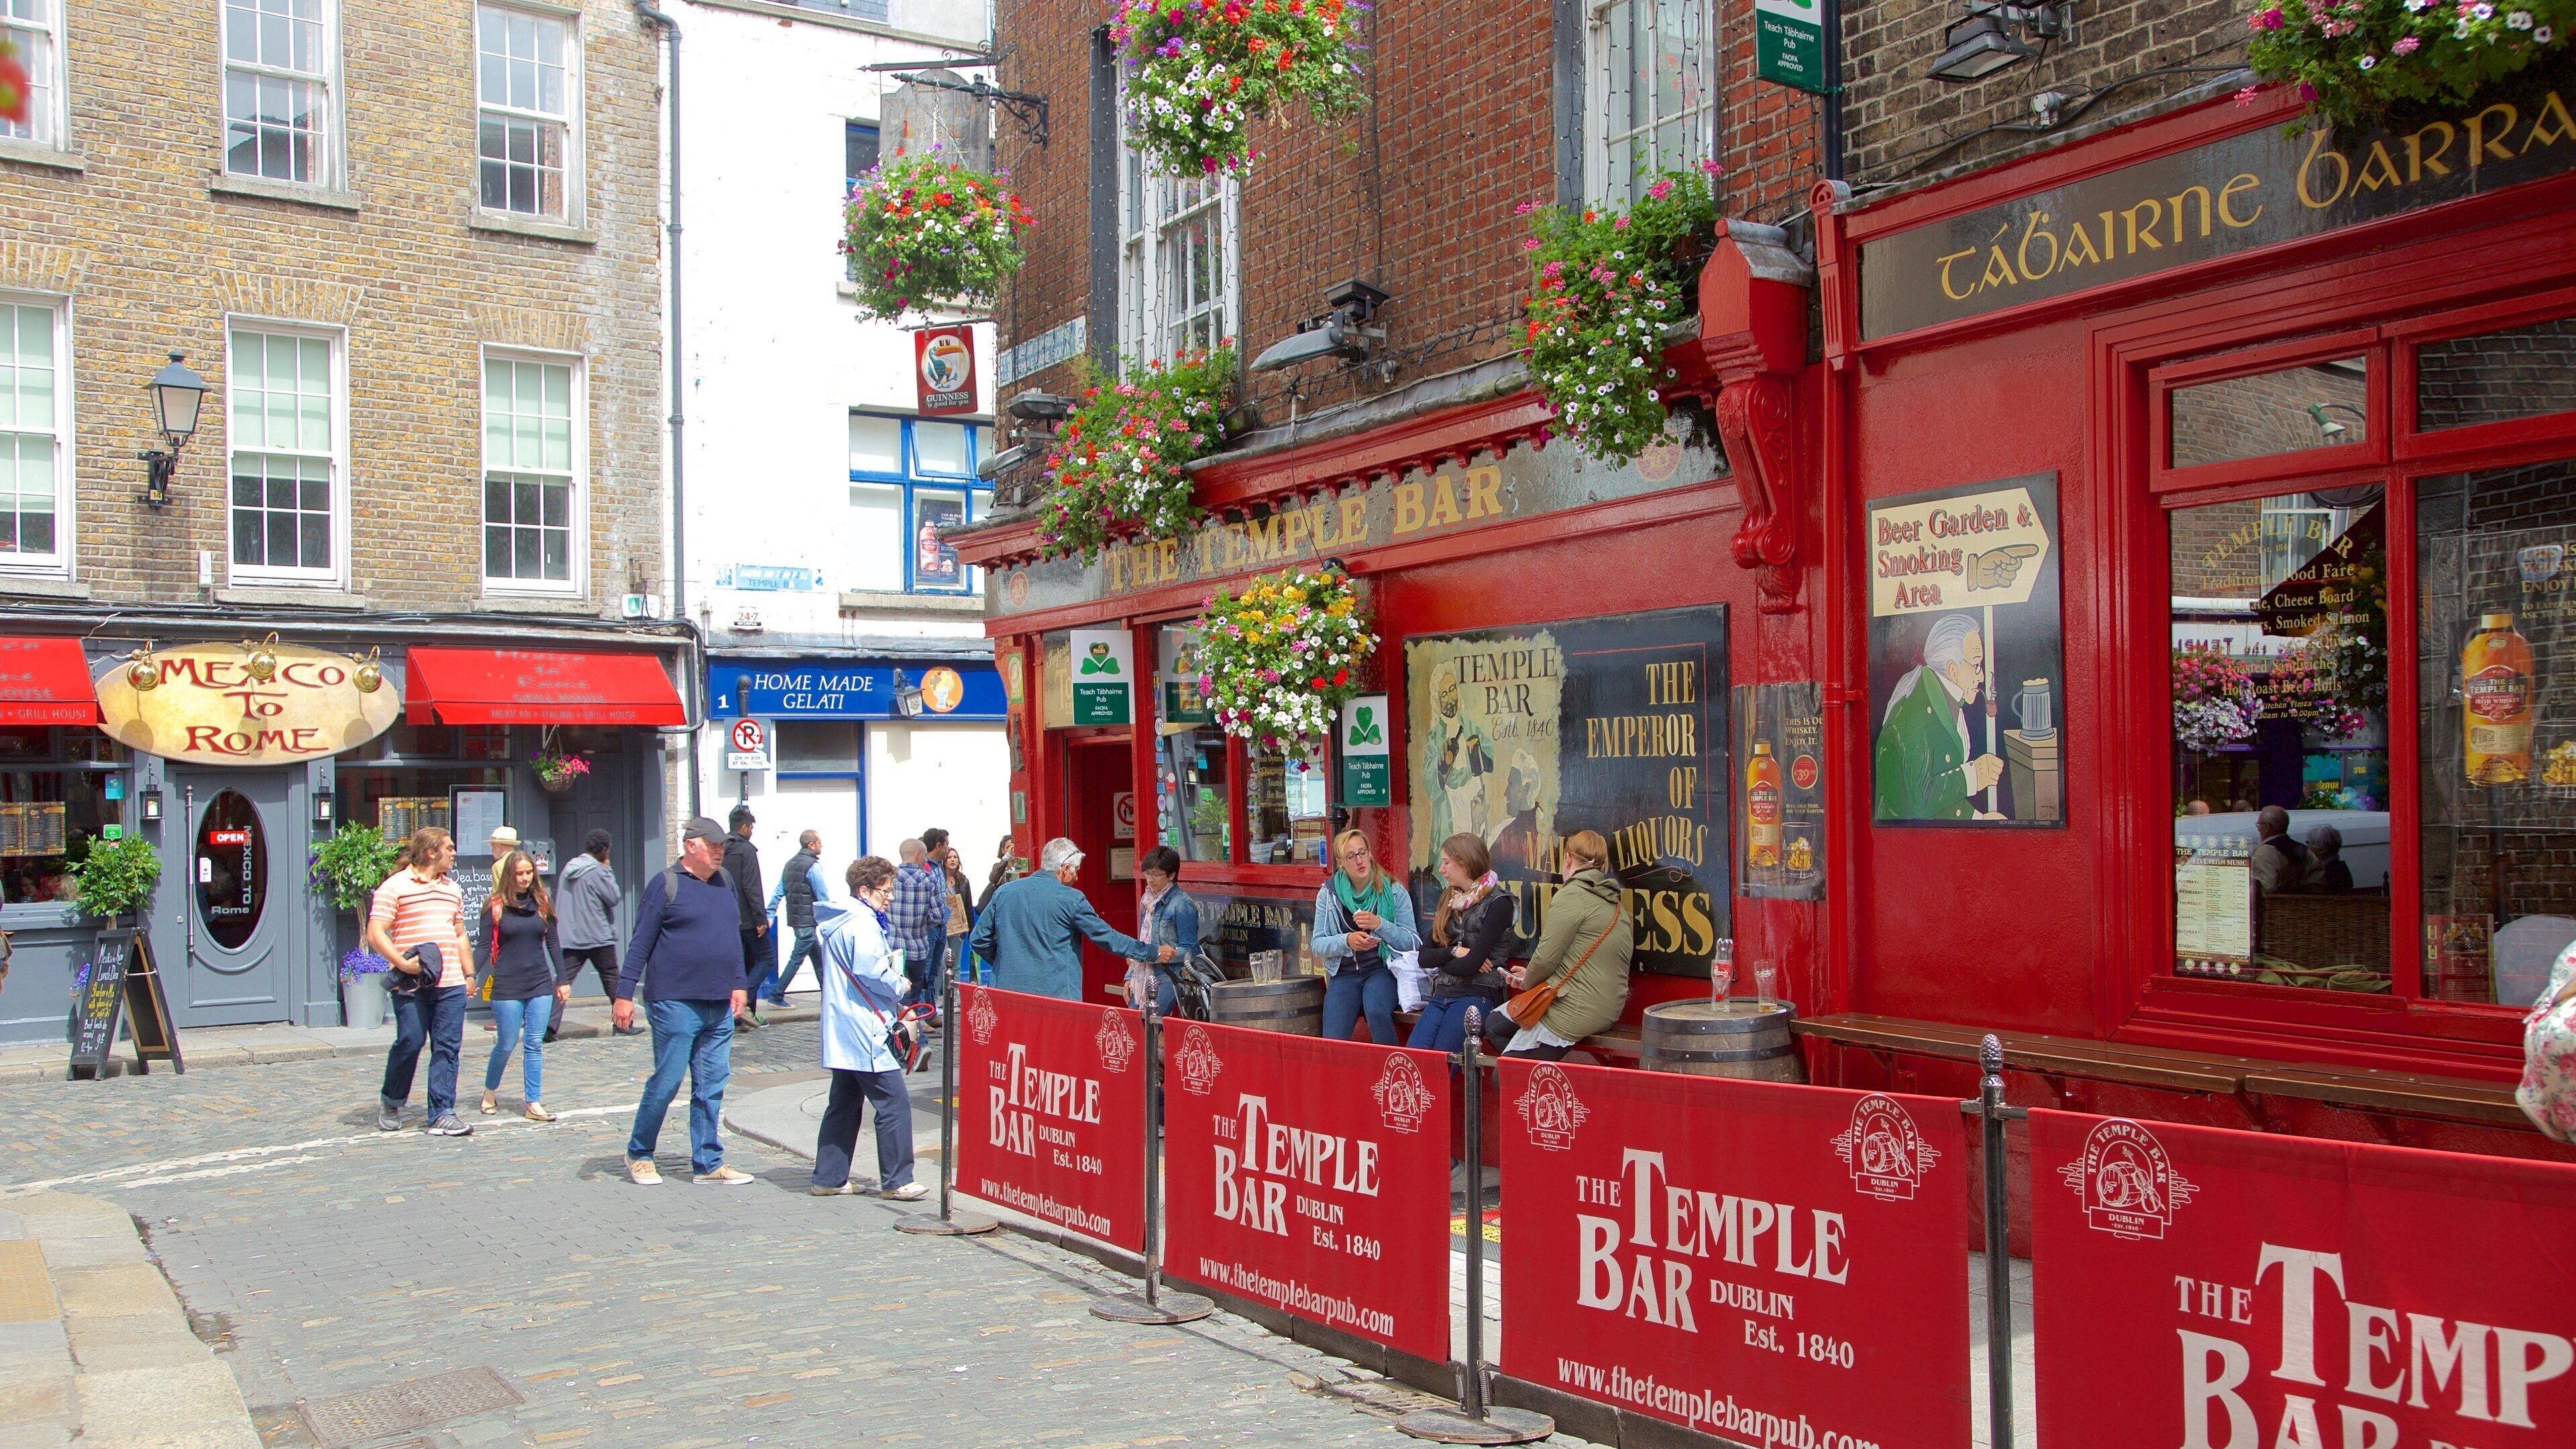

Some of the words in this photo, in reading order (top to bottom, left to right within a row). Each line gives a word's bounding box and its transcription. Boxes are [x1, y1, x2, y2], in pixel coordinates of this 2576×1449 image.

[1764, 21, 1782, 34] Teach
[1784, 38, 1796, 49] Pub
[1778, 60, 1803, 72] APPROVED
[926, 392, 969, 402] GUINNESS
[933, 400, 947, 409] good
[1106, 537, 1179, 590] THE
[1194, 494, 1368, 573] TEMPLE
[1393, 465, 1503, 535] BAR
[1877, 515, 1923, 546] Beer
[1929, 503, 2010, 539] Garden
[2017, 502, 2035, 527] &
[2202, 516, 2297, 569] TEMPLE
[2305, 519, 2353, 558] BAR
[1878, 543, 1964, 578] Smoking
[748, 579, 780, 588] TEMPLE
[2200, 568, 2275, 590] Traditional
[2284, 567, 2316, 582] Food
[2322, 564, 2355, 578] Fare
[2521, 580, 2569, 594] ENJOY
[1894, 582, 1943, 608] Area
[2275, 594, 2314, 608] Cheese
[2319, 589, 2354, 605] Board
[2276, 614, 2321, 629] Smoked
[2325, 611, 2371, 625] Salmon
[2521, 611, 2538, 619] ASK
[1454, 647, 1558, 684] TEMPLE
[2229, 661, 2267, 674] Toasted
[753, 674, 811, 690] HOME
[817, 675, 873, 692] MADE
[1646, 660, 1695, 706] THE
[2222, 682, 2241, 696] Hot
[2248, 680, 2277, 694] Roast
[2313, 677, 2343, 692] Rolls
[2470, 684, 2506, 694] TEMPLE
[2508, 684, 2526, 692] BAR
[718, 694, 729, 708] 1
[782, 693, 845, 710] GELATI
[1485, 684, 1534, 717] BAR
[17, 708, 48, 719] GRILL
[51, 708, 87, 720] HOUSE
[1786, 717, 1801, 725] THIS
[1526, 718, 1554, 737] 1840
[1585, 713, 1697, 759] EMPEROR
[182, 726, 329, 756] ROME
[1786, 737, 1807, 745] ENJOY
[1669, 766, 1697, 810] OF
[217, 833, 244, 842] OPEN
[1613, 815, 1709, 871] LIQUORS
[2196, 849, 2229, 857] TEMPLE
[211, 906, 250, 914] Rome
[1208, 902, 1260, 926] TEMPLE
[1264, 906, 1295, 930] BAR
[1222, 928, 1248, 942] DUBLIN
[989, 1060, 1006, 1081] THE
[1007, 1042, 1101, 1124] TEMPLE
[1534, 1066, 1563, 1081] TEMPLE
[1562, 1082, 1572, 1109] BAR
[989, 1085, 1036, 1159] BAR
[1038, 1126, 1076, 1148] DUBLIN
[1854, 1116, 1864, 1144] THE
[1859, 1099, 1900, 1118] TEMPLE
[1900, 1118, 1915, 1150] BAR
[1213, 1114, 1237, 1140] THE
[1237, 1092, 1381, 1198] TEMPLE
[1540, 1132, 1560, 1140] DUBLIN
[1053, 1148, 1073, 1169] Est.
[1076, 1155, 1102, 1176] 1840
[2087, 1143, 2100, 1175] THE
[2095, 1124, 2149, 1147] TEMPLE
[2149, 1146, 2167, 1184] BAR
[1214, 1144, 1289, 1238] BAR
[1296, 1194, 1344, 1226] DUBLIN
[1871, 1178, 1898, 1188] DUBLIN
[981, 1177, 1111, 1236] www.thetemplebarpub.com
[1575, 1175, 1621, 1208] THE
[1621, 1146, 1850, 1286] TEMPLE
[2108, 1213, 2145, 1226] DUBLIN
[1313, 1225, 1339, 1252] Est.
[1345, 1234, 1381, 1262] 1840
[1576, 1214, 1698, 1334] BAR
[1709, 1279, 1794, 1320] DUBLIN
[1199, 1256, 1395, 1338] www.thetemplebarpub.com
[1744, 1319, 1785, 1354] Est.
[1797, 1331, 1855, 1370] 1840
[2174, 1274, 2253, 1326] THE
[2255, 1240, 2576, 1430] TEMP
